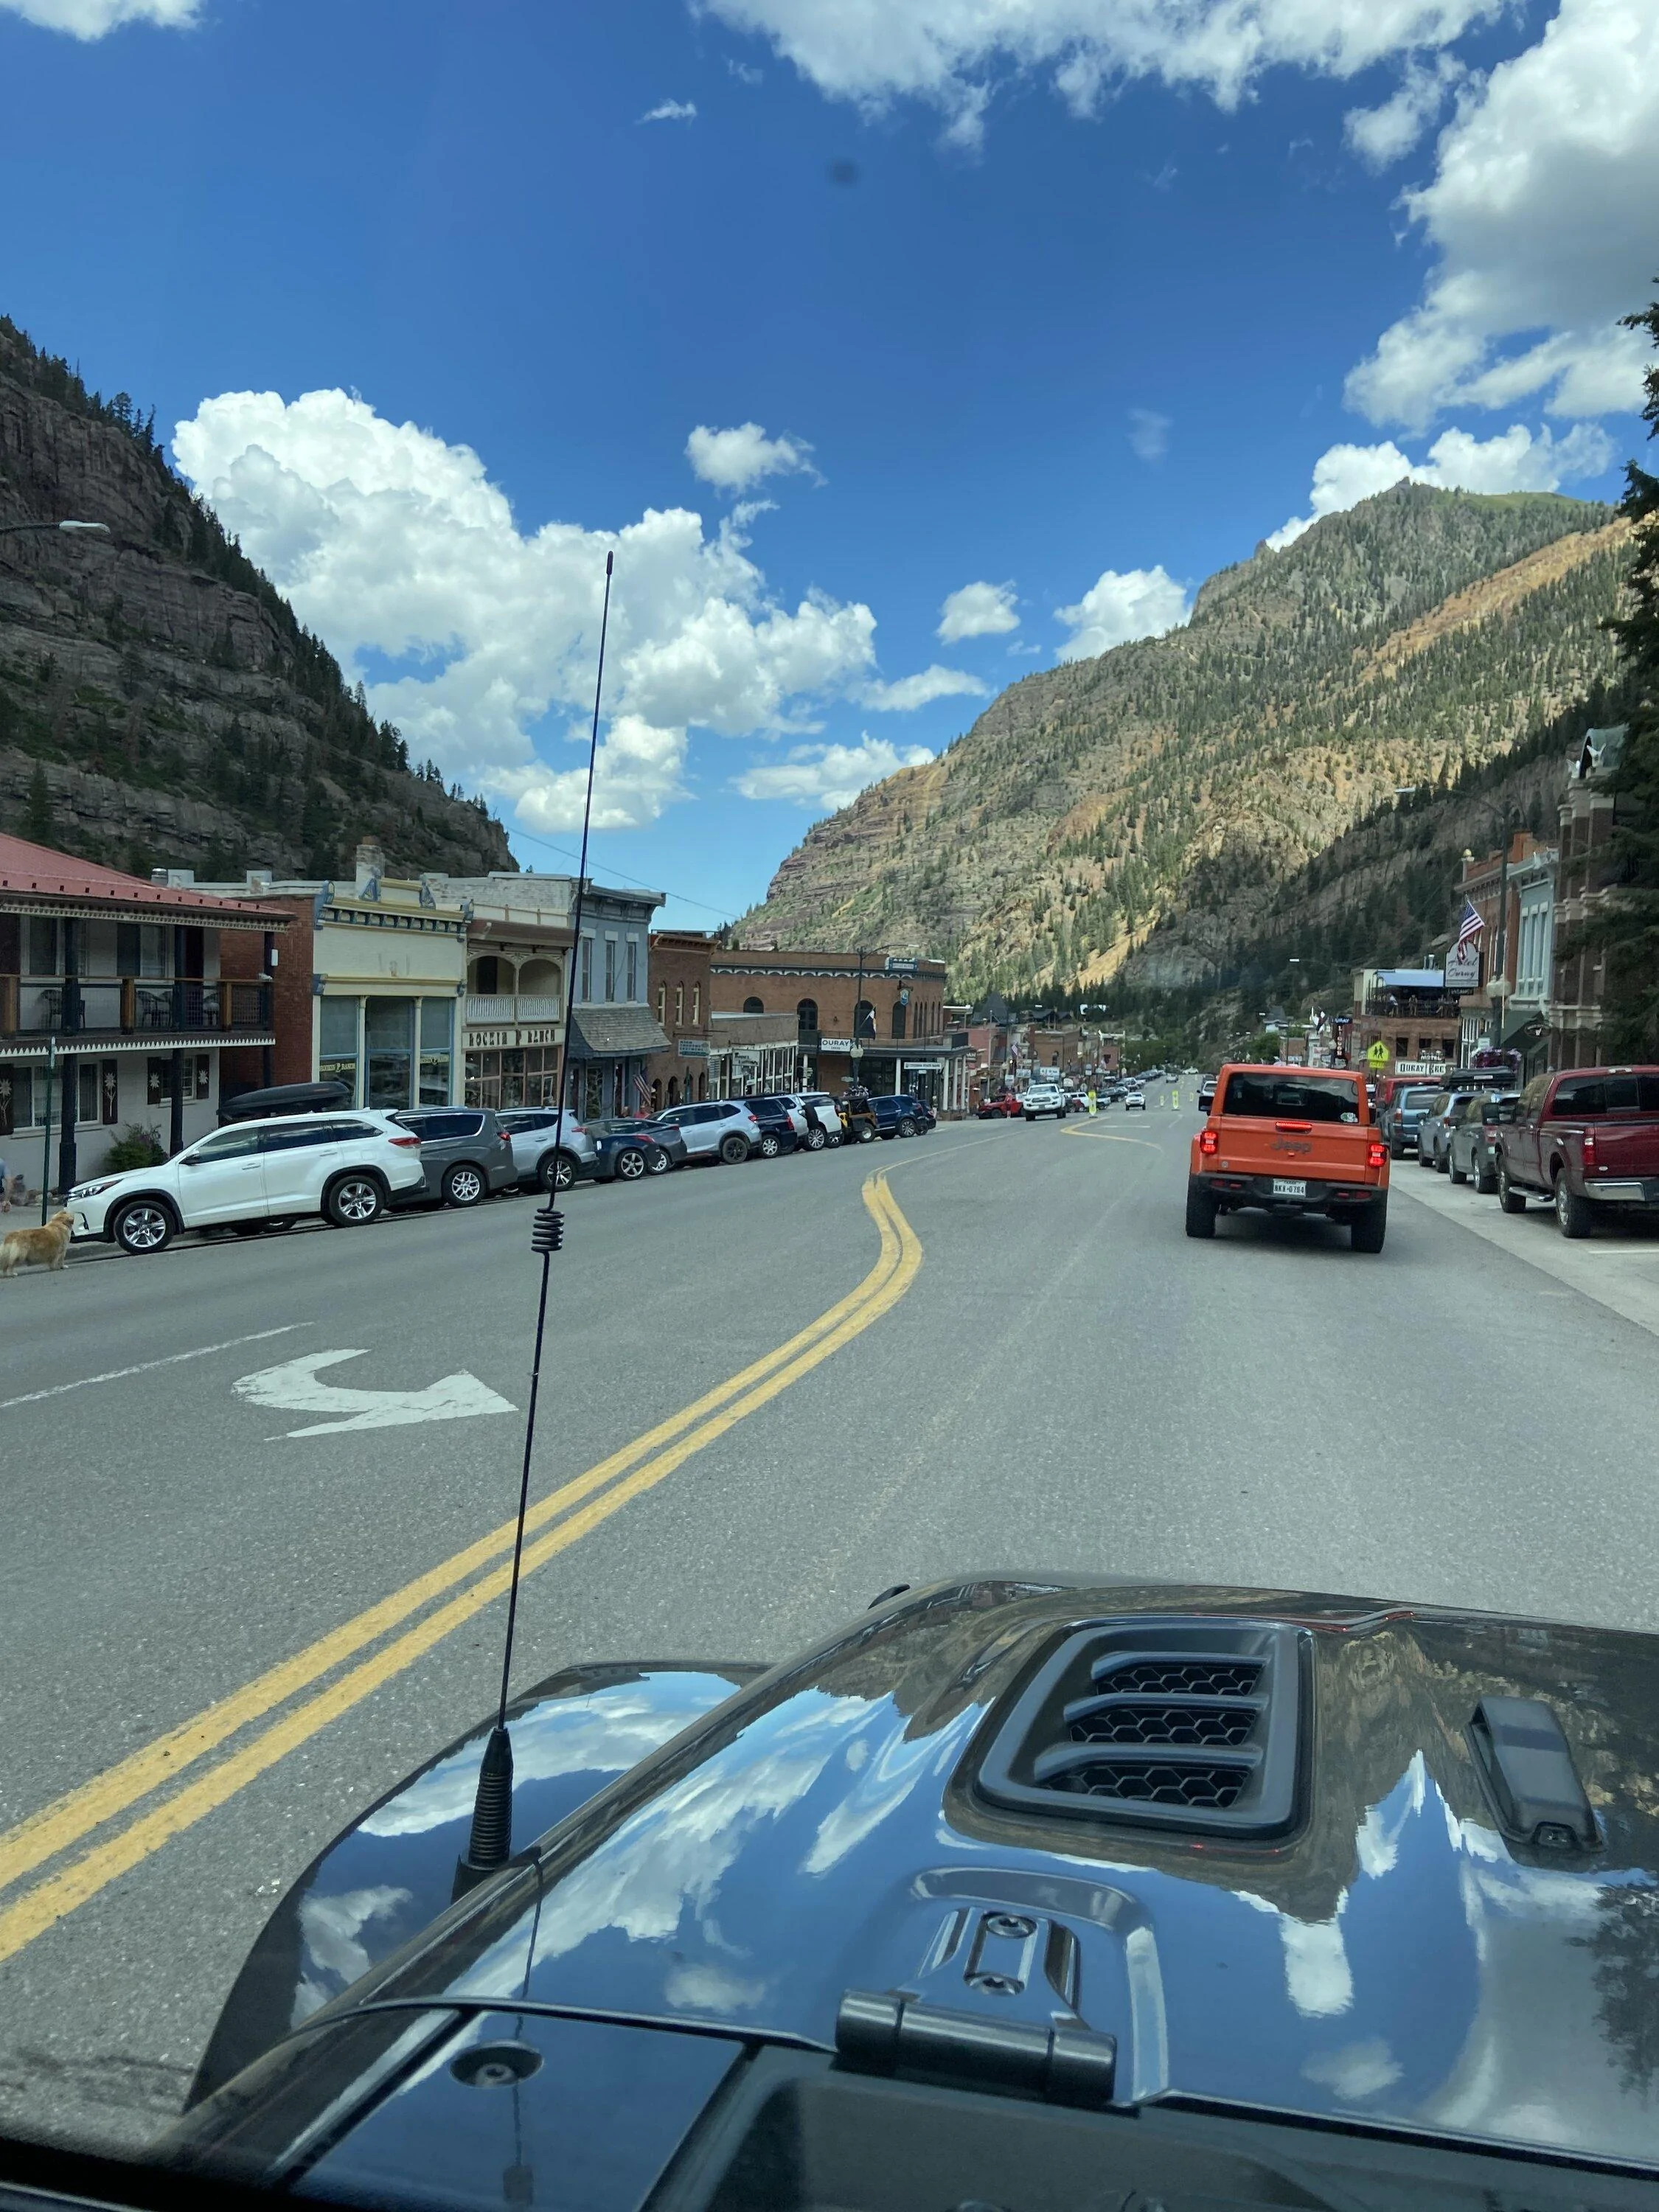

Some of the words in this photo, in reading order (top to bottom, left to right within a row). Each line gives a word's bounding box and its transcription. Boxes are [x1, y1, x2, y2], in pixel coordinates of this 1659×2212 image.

[469, 1032, 507, 1047] ROCKIN
[1400, 1063, 1424, 1072] OURAY
[1270, 1135, 1312, 1154] Jeep
